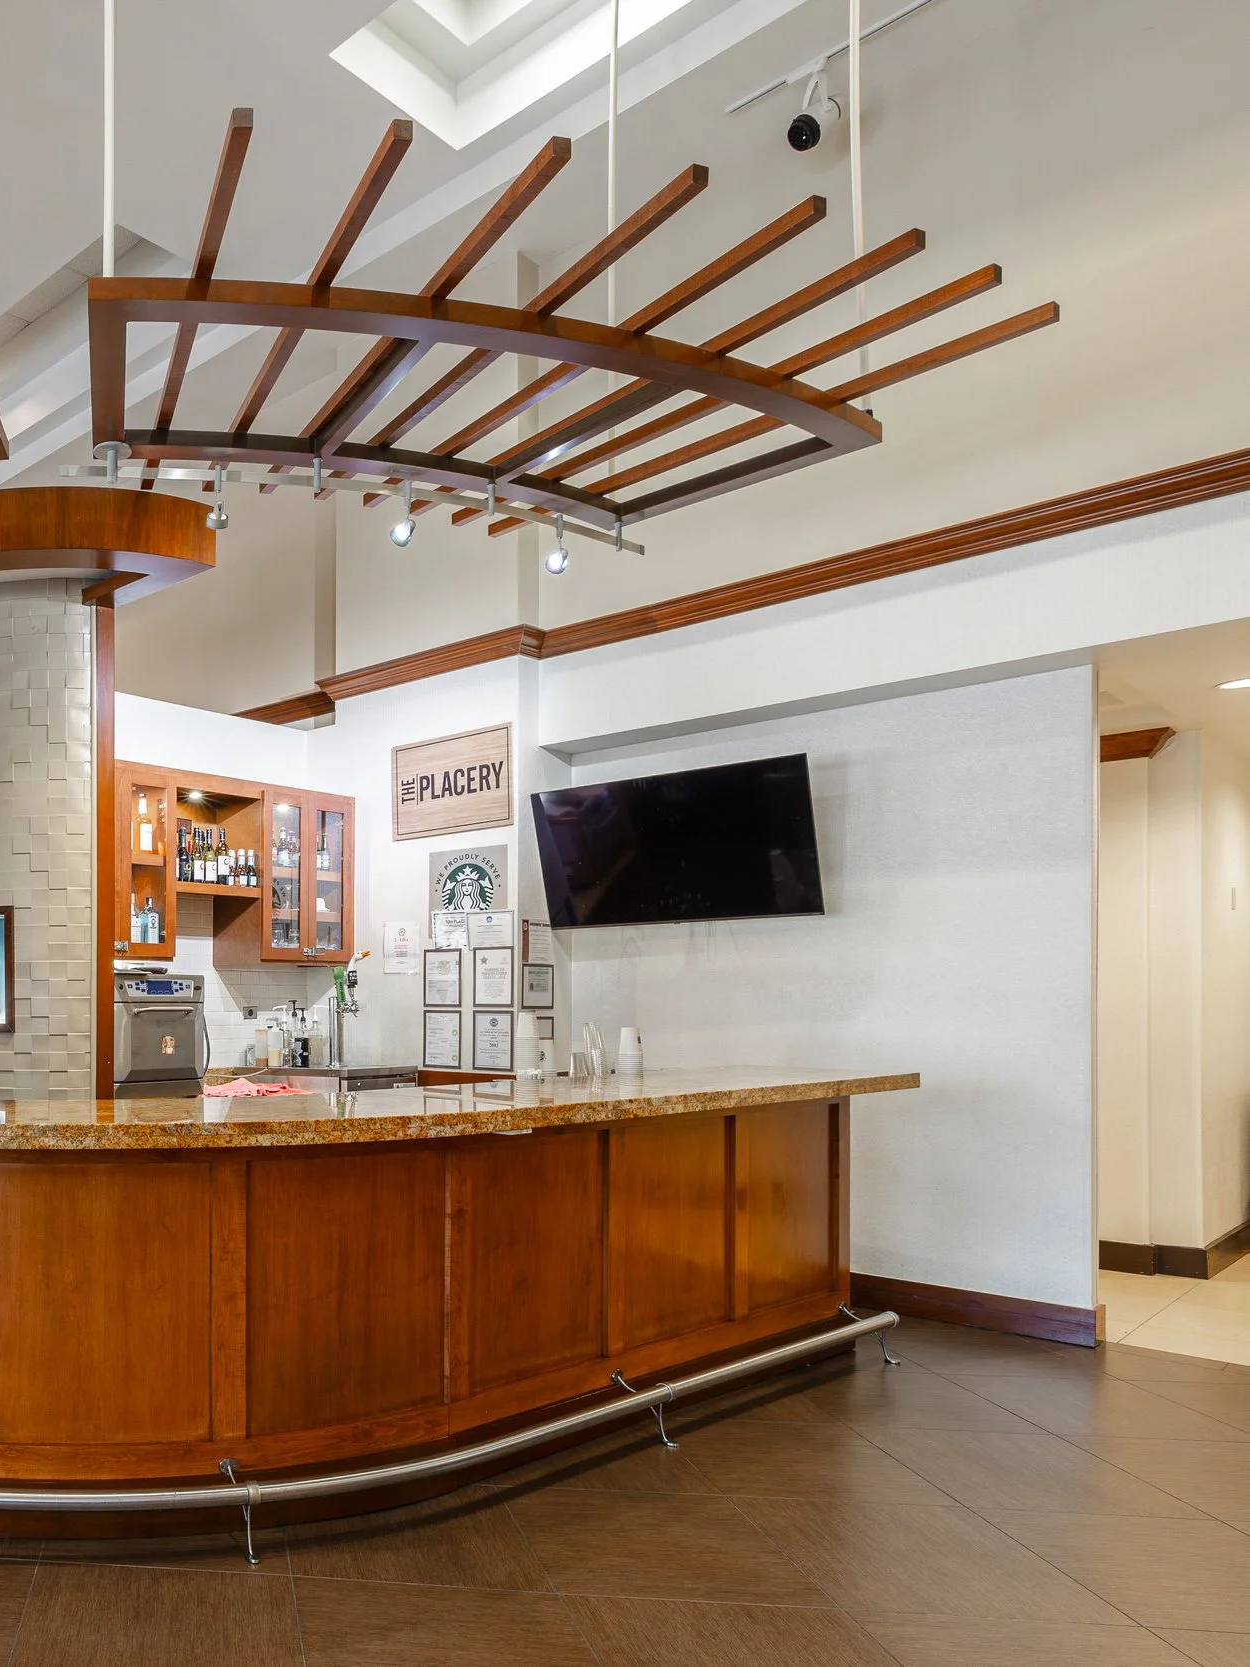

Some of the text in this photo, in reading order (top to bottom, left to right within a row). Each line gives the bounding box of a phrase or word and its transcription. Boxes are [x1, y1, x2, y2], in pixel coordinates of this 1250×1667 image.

[401, 777, 415, 805] THE
[419, 760, 504, 802] PLACERY
[435, 853, 501, 885] WE PROUDLY SERVE
